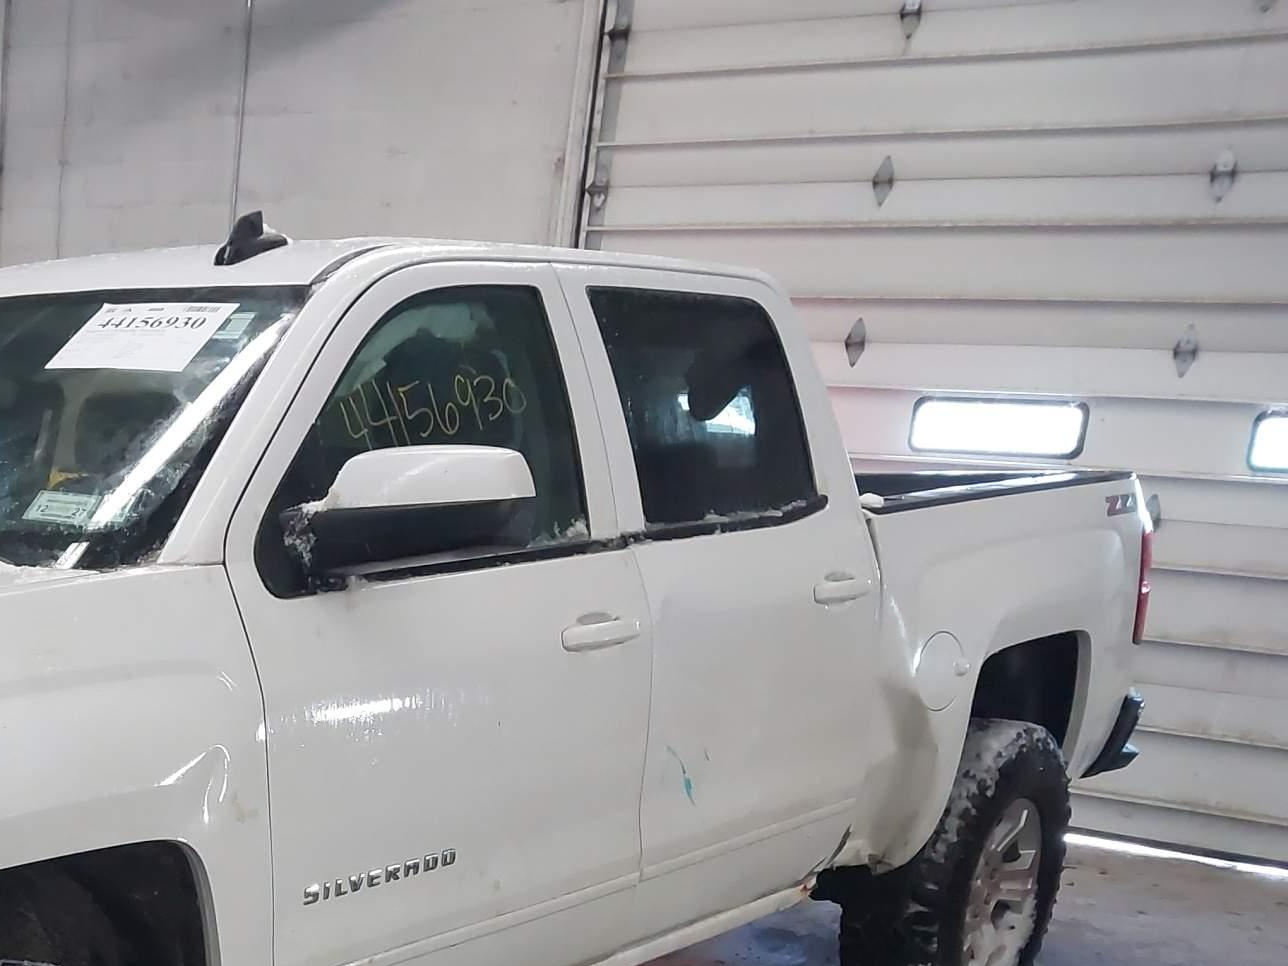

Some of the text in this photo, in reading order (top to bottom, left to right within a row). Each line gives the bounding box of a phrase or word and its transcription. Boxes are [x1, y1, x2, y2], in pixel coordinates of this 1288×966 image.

[96, 316, 207, 329] 44156930
[339, 374, 527, 450] 44156930
[302, 848, 457, 906] SILVERADO
